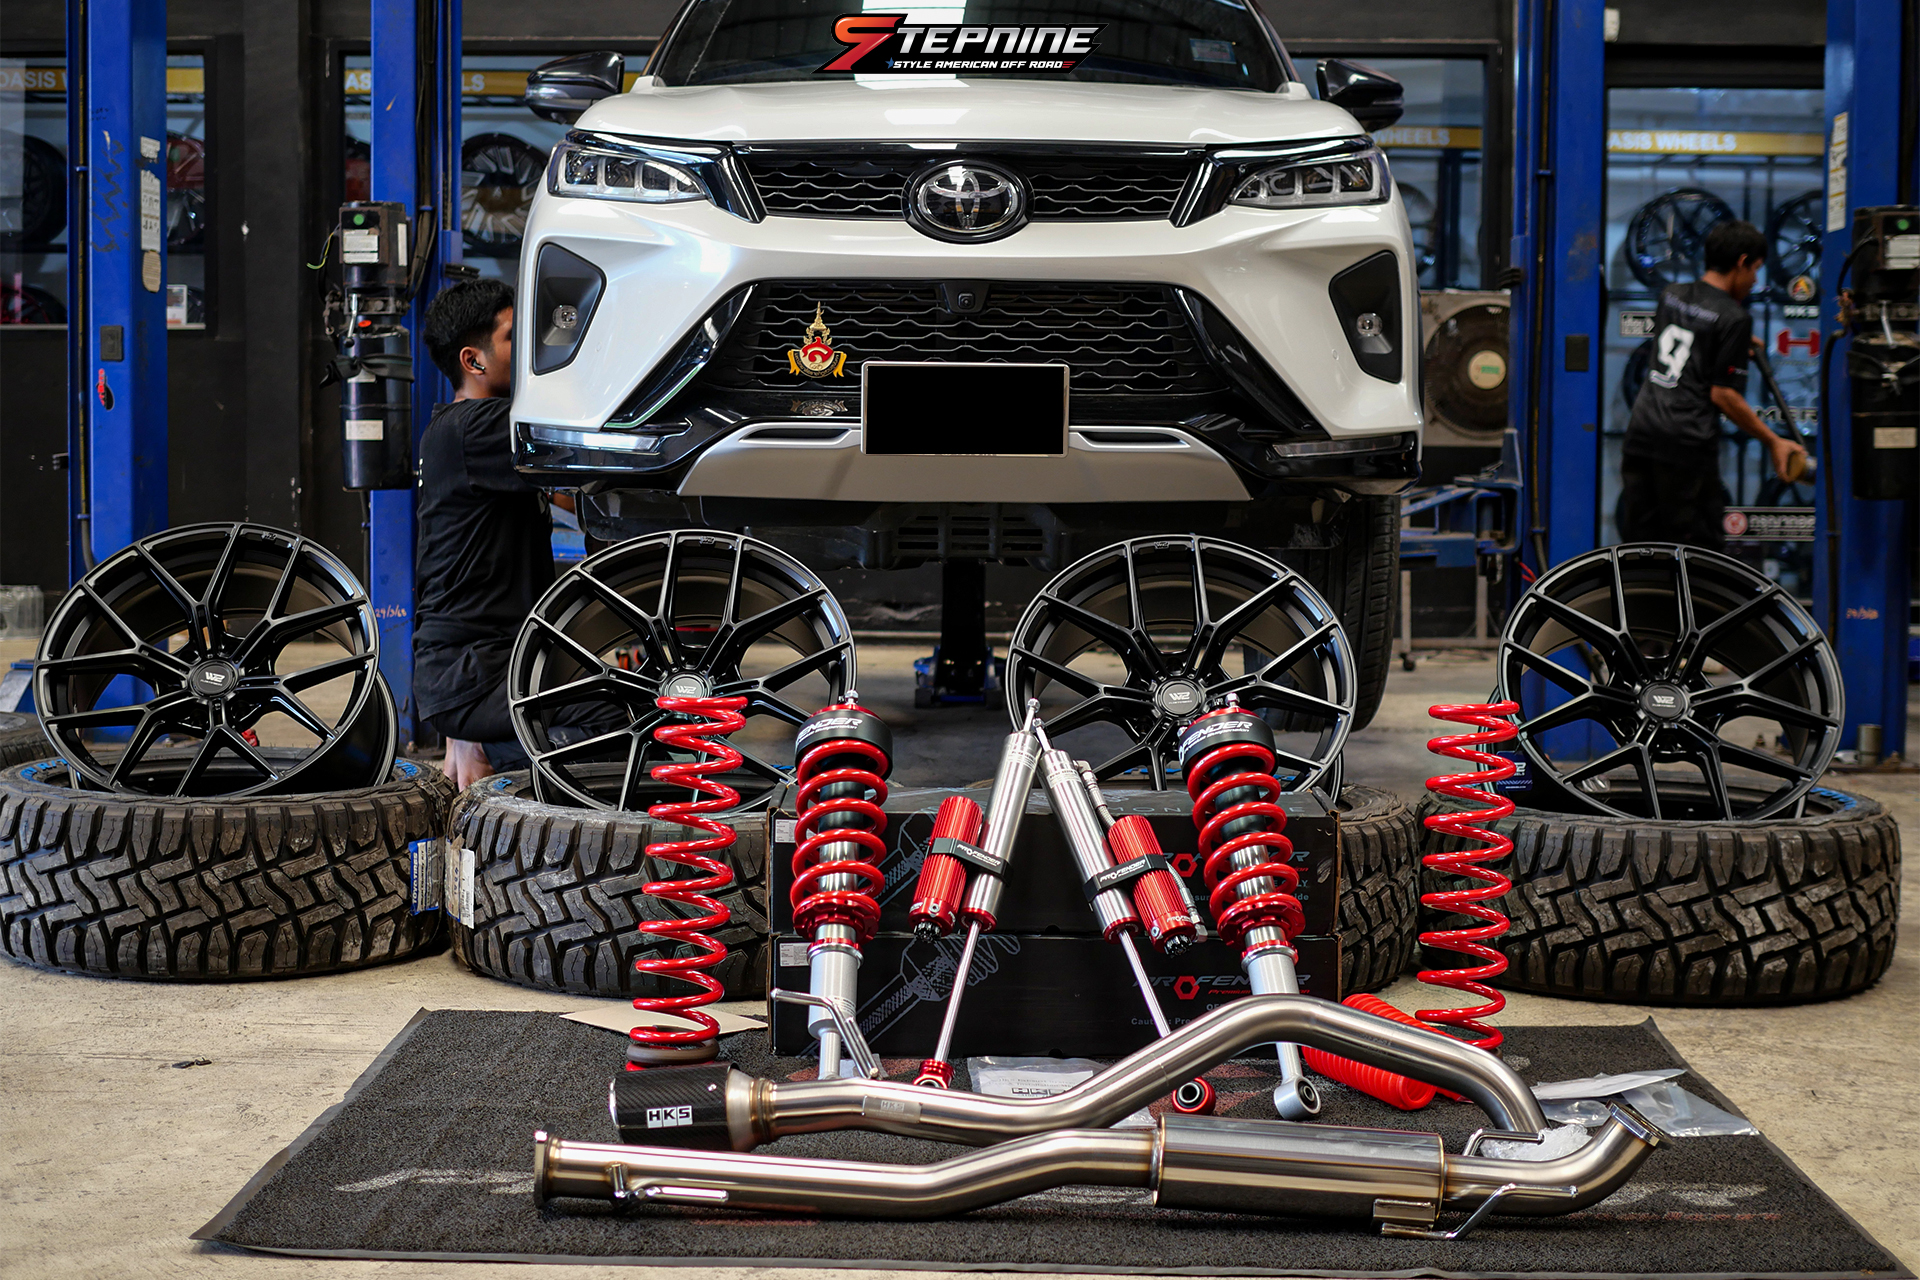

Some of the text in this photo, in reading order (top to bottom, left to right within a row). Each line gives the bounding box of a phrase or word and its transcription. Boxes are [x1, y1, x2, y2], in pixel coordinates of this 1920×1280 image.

[0, 71, 56, 89] OASIS
[1608, 132, 1737, 151] ASIS WHEELS
[648, 1107, 692, 1123] HKS
